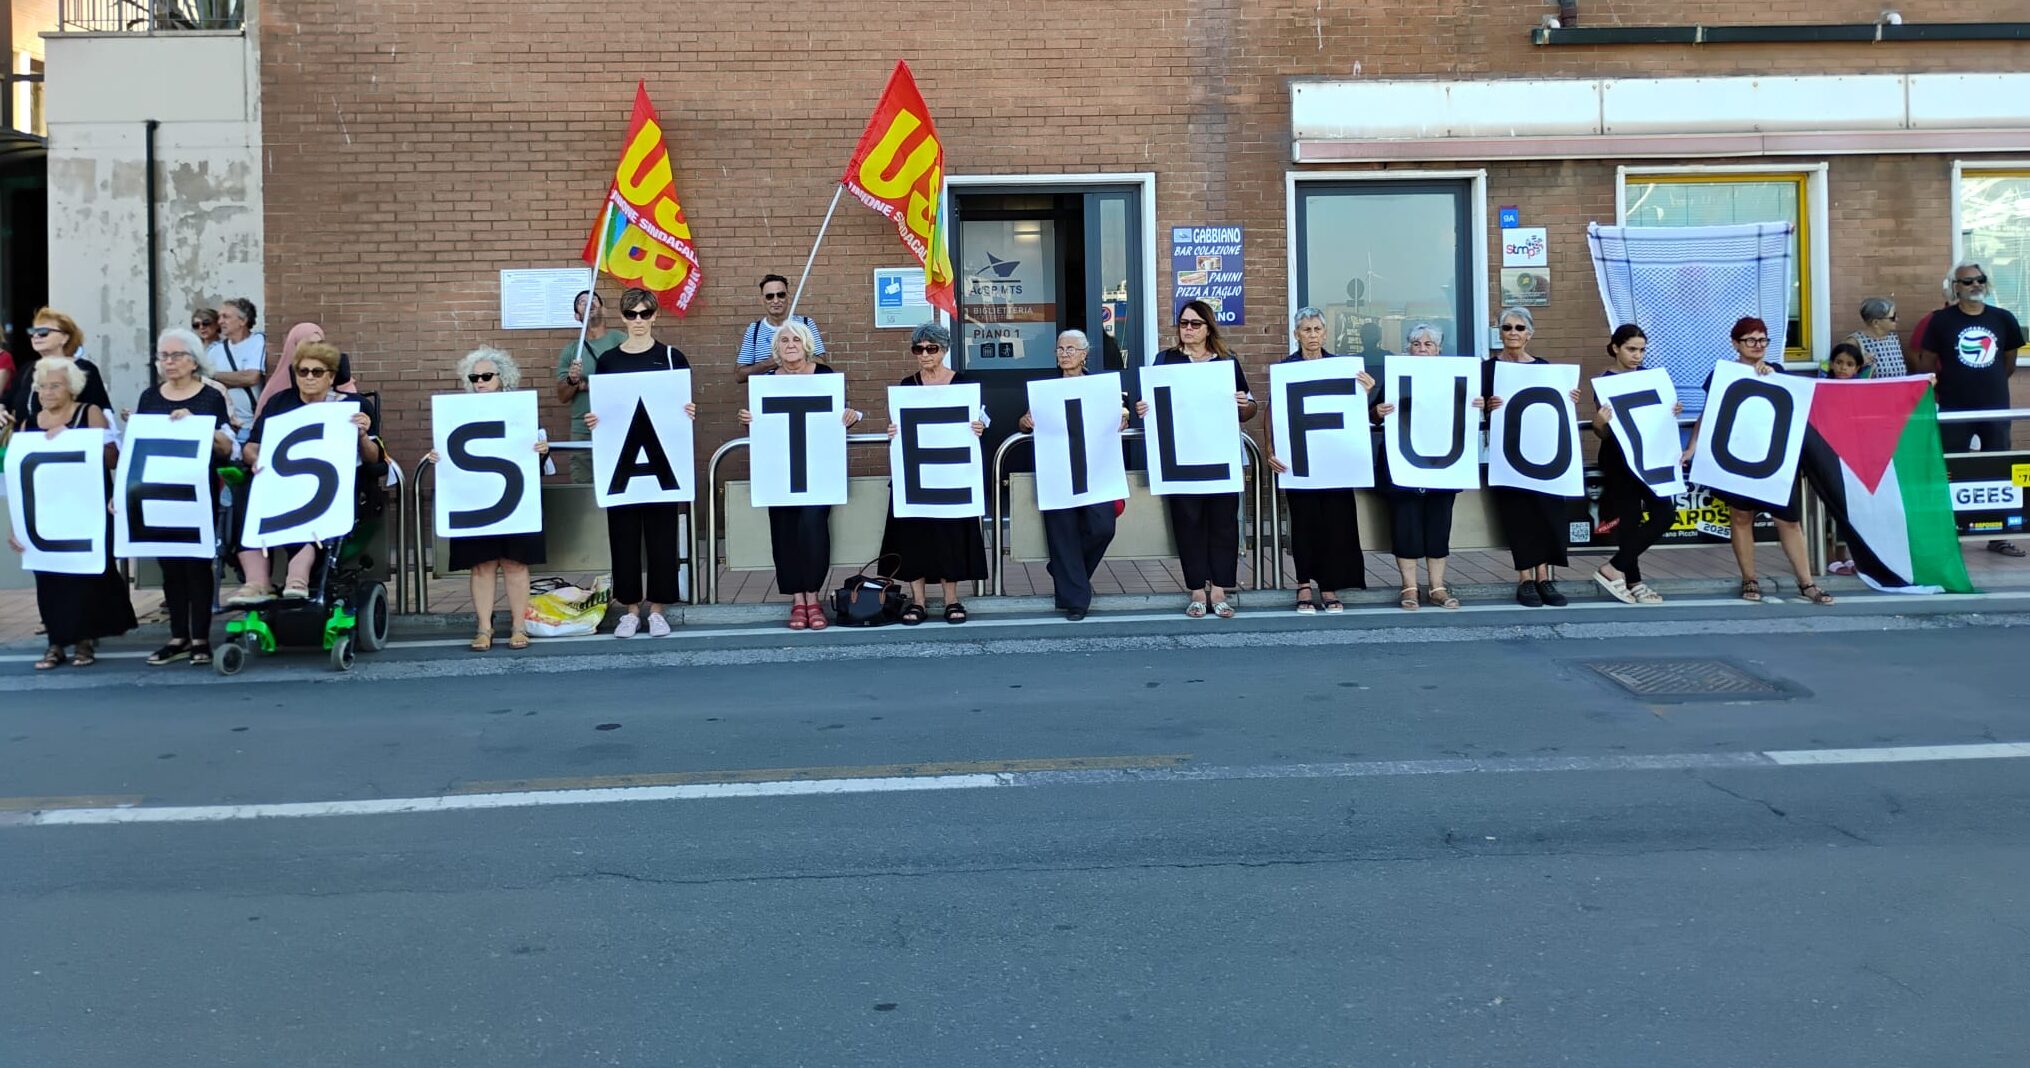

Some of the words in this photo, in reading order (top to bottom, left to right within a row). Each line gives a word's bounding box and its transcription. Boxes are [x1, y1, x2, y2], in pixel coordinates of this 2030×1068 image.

[1193, 227, 1241, 243] GABBIANO
[1174, 246, 1193, 256] BAR
[1194, 245, 1242, 256] COLAZIONE
[1209, 272, 1243, 283] PANINI
[1175, 286, 1201, 297] PIZZA
[1202, 286, 1209, 297] A
[1211, 286, 1242, 299] TAGLIO
[973, 307, 1034, 315] BIGLIETTERIA
[973, 329, 1011, 339] PIANO
[1014, 329, 1020, 338] 1
[1956, 486, 2014, 504] GEES
[1703, 523, 1731, 536] 2025
